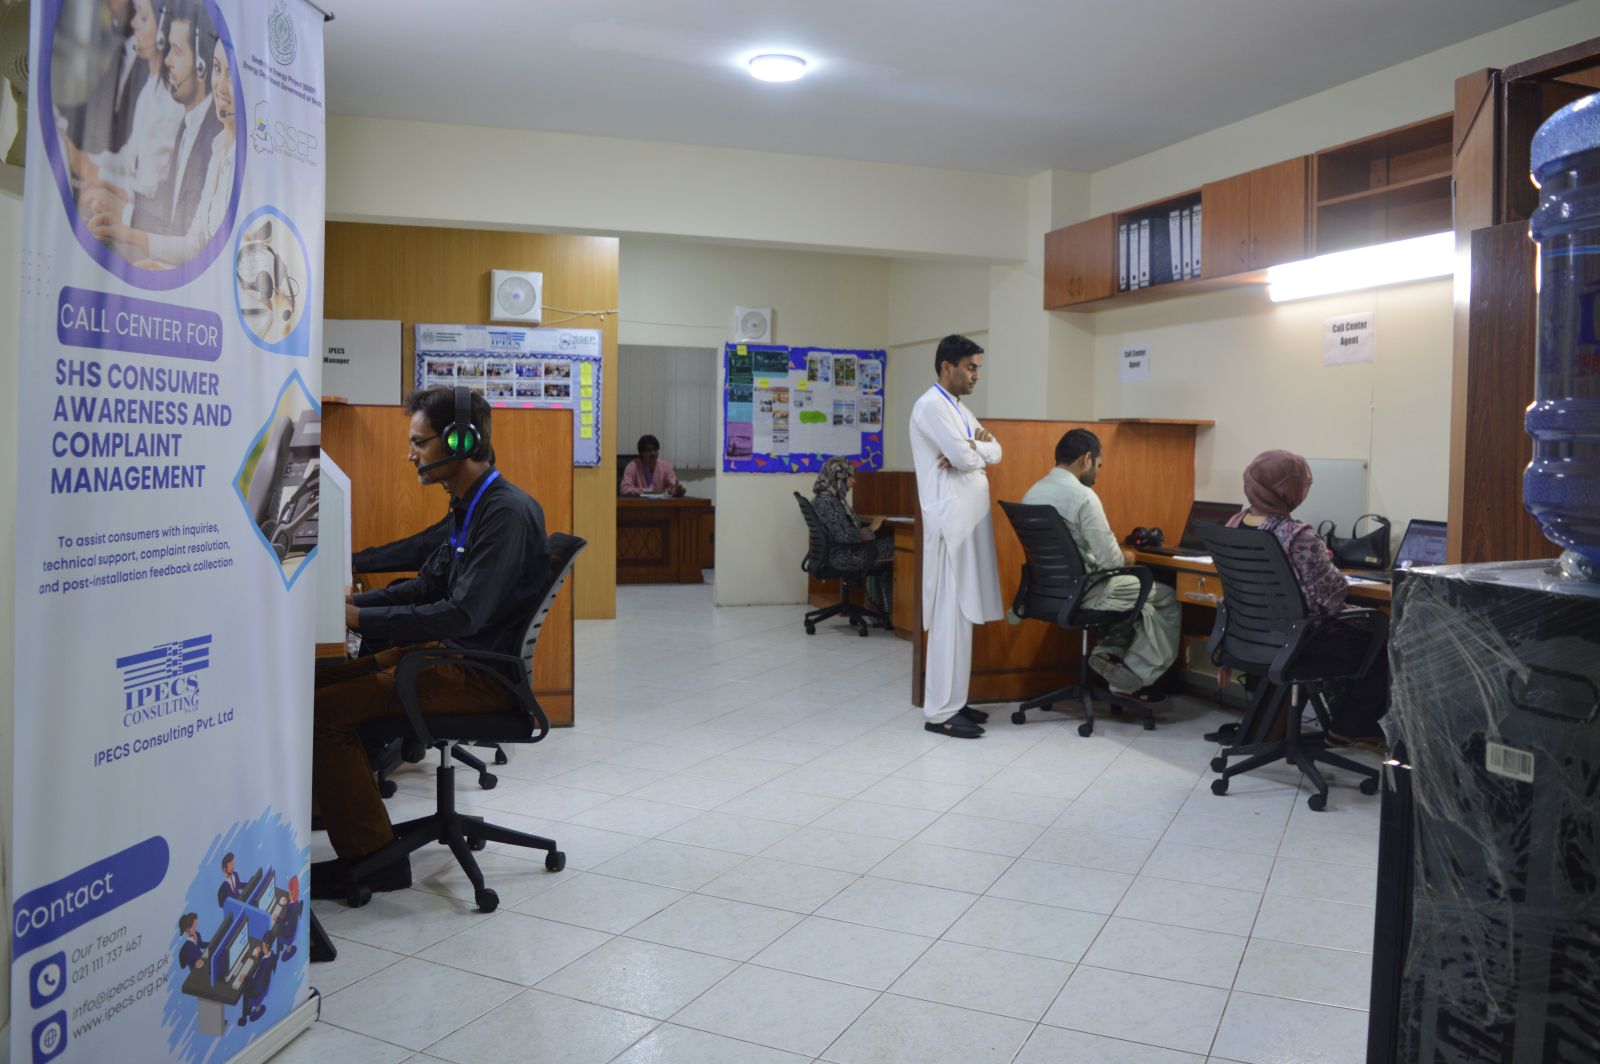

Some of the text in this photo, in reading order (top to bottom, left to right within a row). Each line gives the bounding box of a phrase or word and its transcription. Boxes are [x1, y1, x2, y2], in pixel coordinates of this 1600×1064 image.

[61, 304, 218, 348] CALL CENTER FOR
[1333, 321, 1367, 333] Call Center
[1340, 336, 1358, 346] Agent
[56, 358, 219, 396] SHS CONSUMER
[53, 395, 232, 427] AWARENESS AND
[52, 431, 182, 458] COMPLAINT
[51, 465, 205, 494] MANAGEMENT
[58, 523, 220, 548] To assist consumers with inquiries,
[43, 540, 231, 572] technical support, complaint resolution,
[39, 557, 233, 595] and post-installation feedback collection
[124, 690, 199, 727] CONSULTING
[126, 673, 198, 711] IPECS
[94, 708, 234, 767] IPECS Consulting Pvt. Ltd
[15, 872, 114, 938] Contact
[72, 926, 127, 964] Our Team
[72, 934, 143, 984] 021 111 737 467
[72, 953, 169, 1021] info@ipecs.org.pk
[73, 974, 168, 1039] www.ipecs.org.pk
